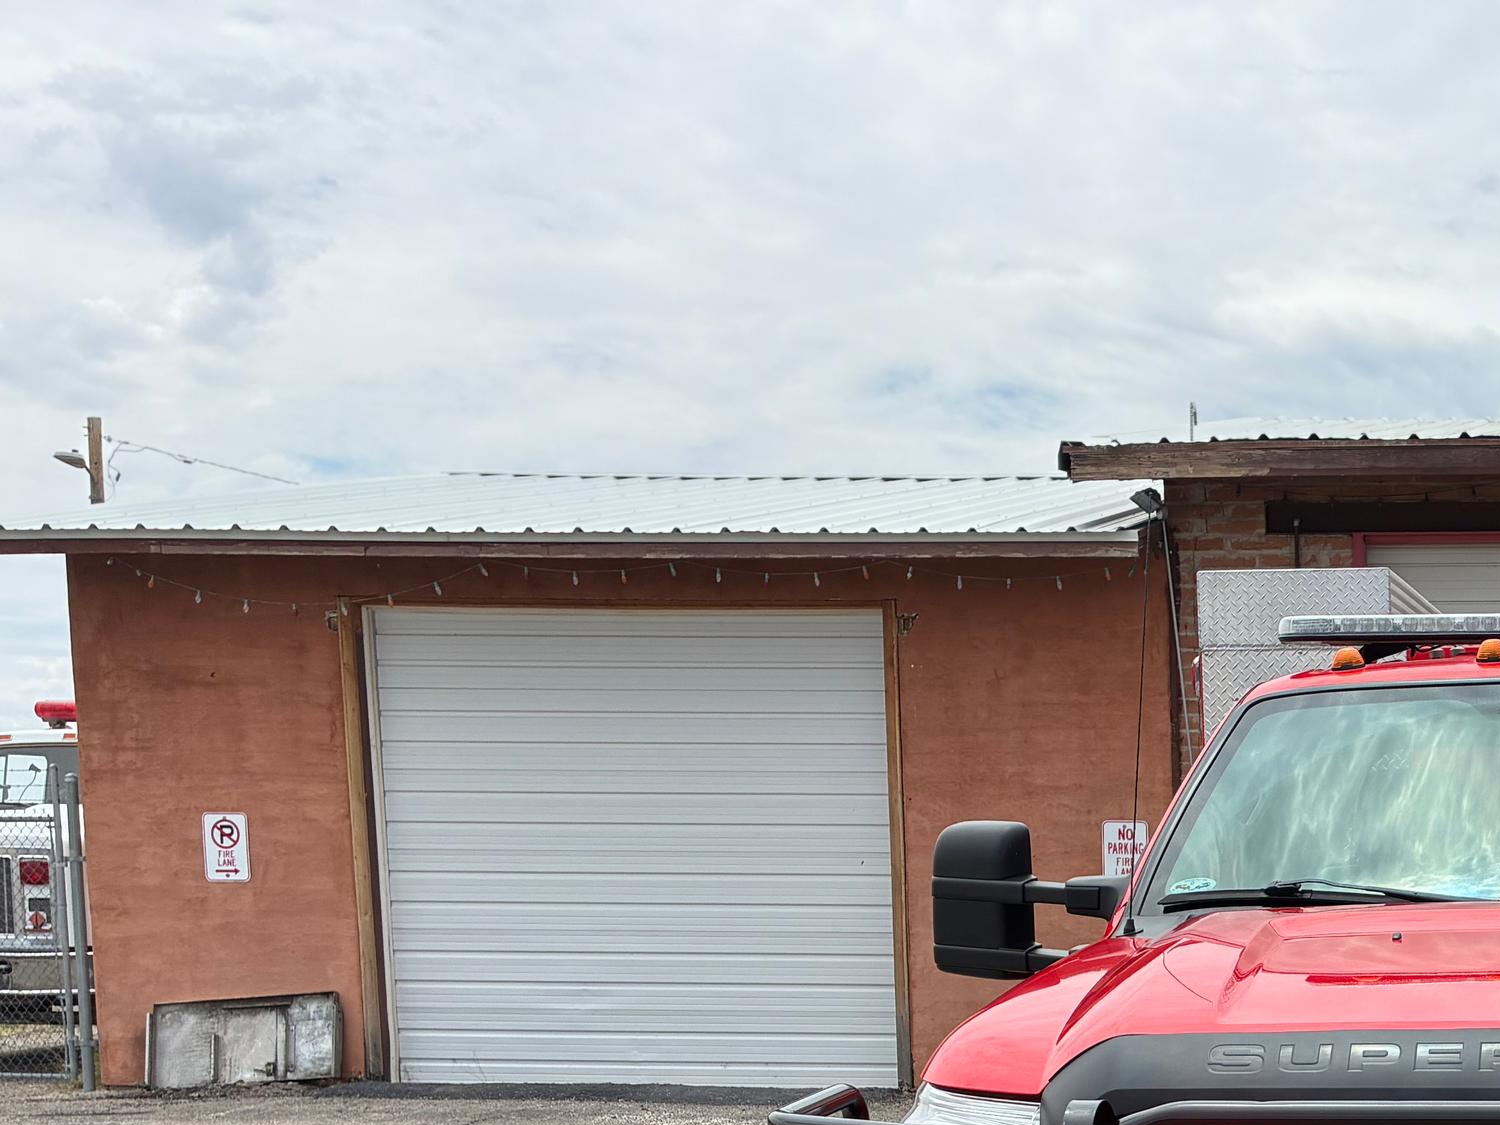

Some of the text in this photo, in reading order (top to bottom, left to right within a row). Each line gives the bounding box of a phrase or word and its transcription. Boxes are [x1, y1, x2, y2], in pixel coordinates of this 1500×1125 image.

[1118, 828, 1134, 841] NO
[218, 850, 235, 858] FIRE
[217, 859, 236, 867] LANE
